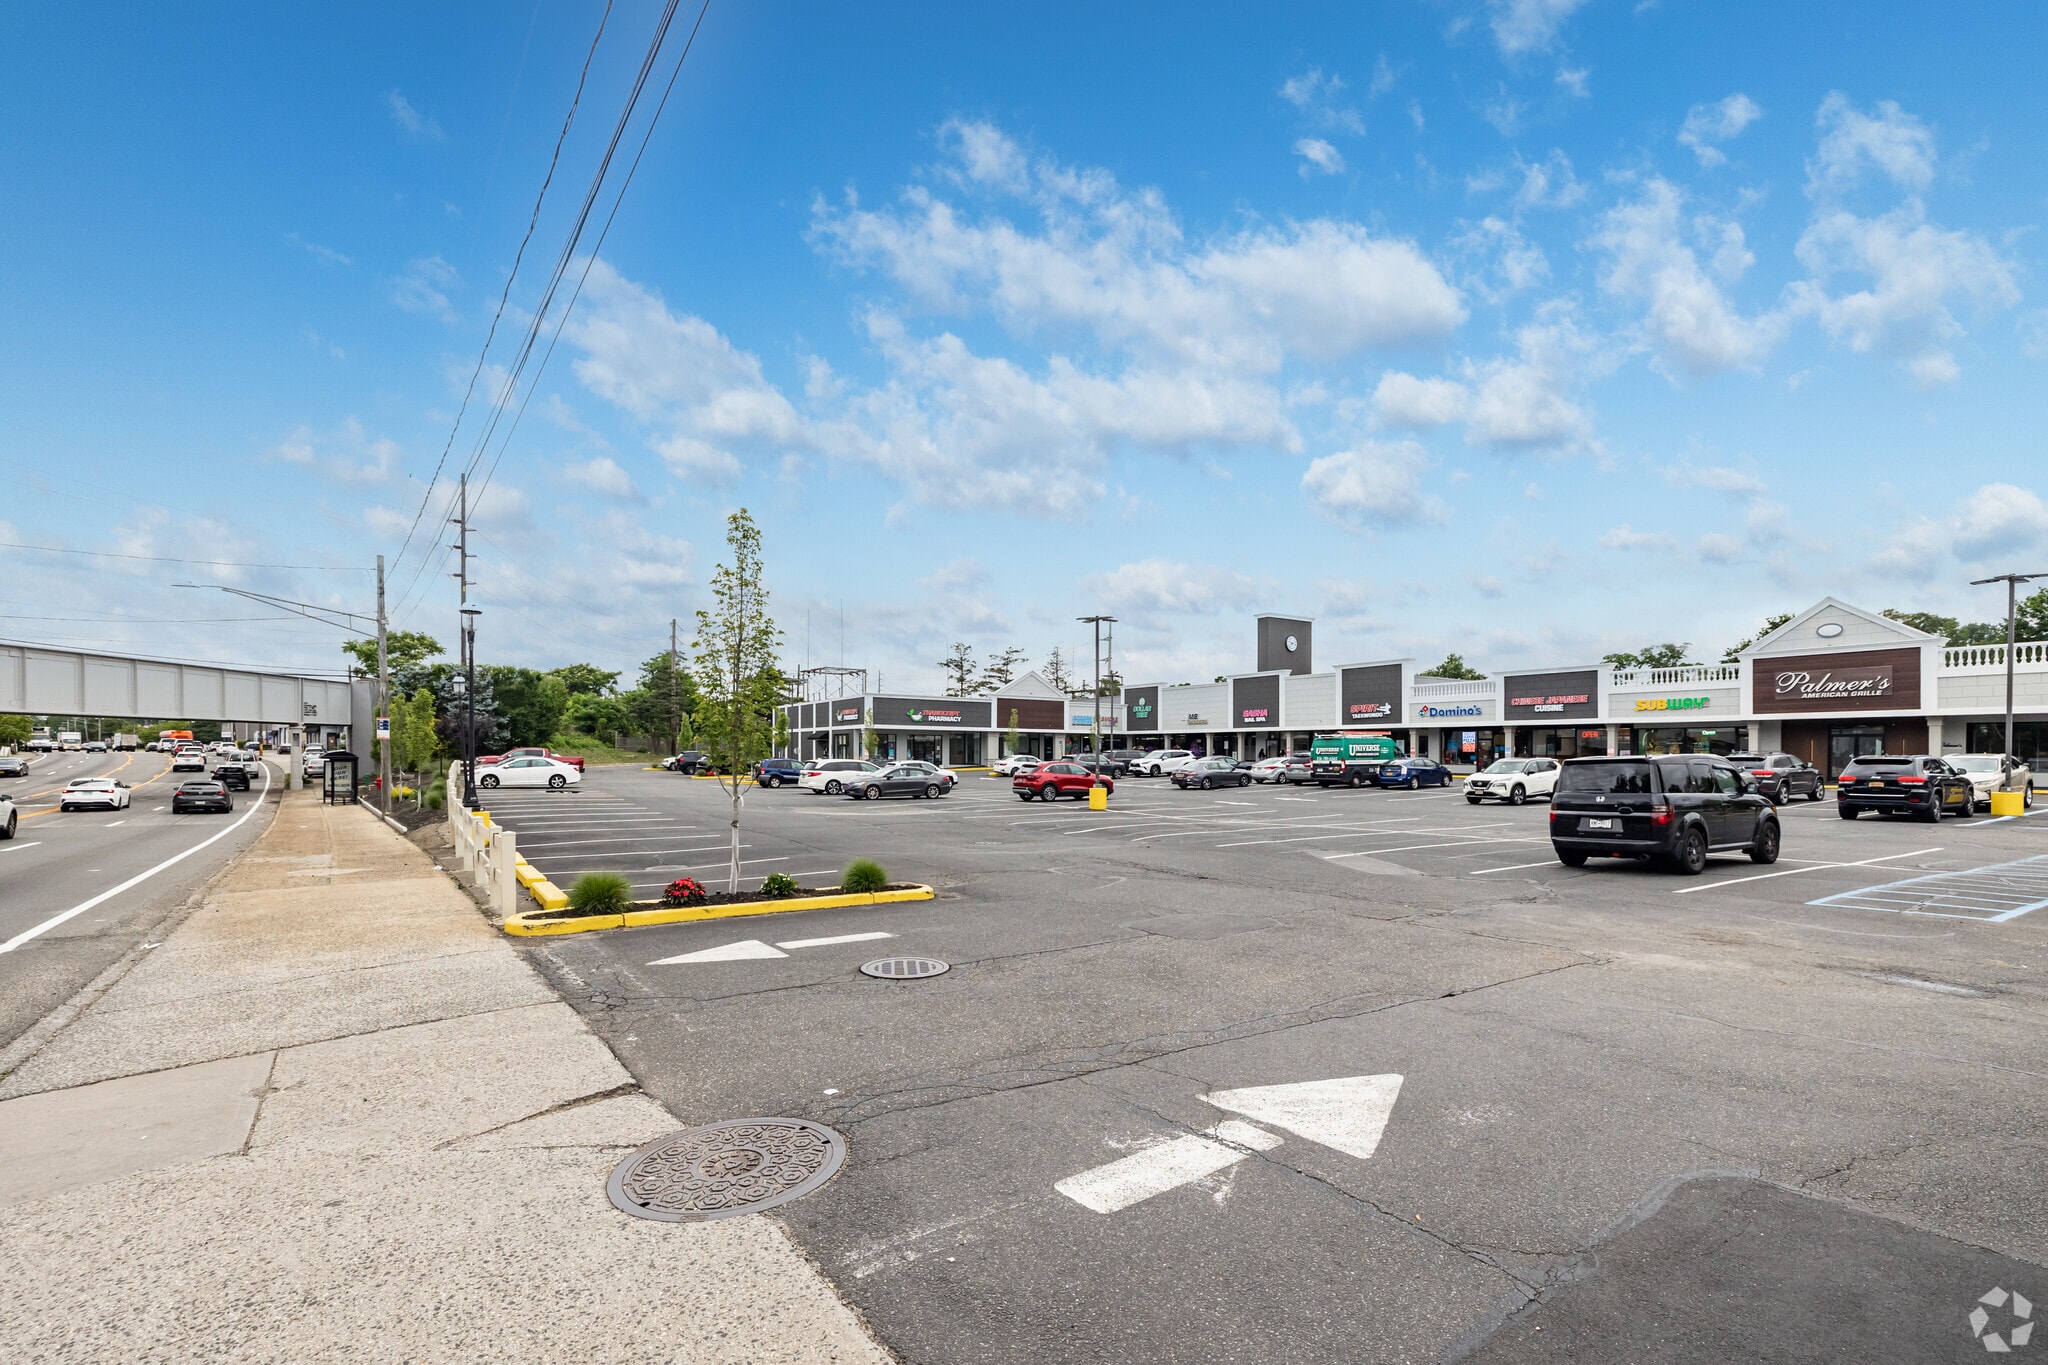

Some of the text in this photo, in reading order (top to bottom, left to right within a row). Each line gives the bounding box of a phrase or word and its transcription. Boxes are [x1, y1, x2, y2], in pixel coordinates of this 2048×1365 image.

[1775, 671, 1891, 694] Palmer's
[1801, 689, 1883, 699] AMERICAN GRILLE
[1511, 695, 1589, 706] CHINESE JAPANESE
[1634, 696, 1710, 712] SUBWAY
[1350, 703, 1379, 713] SPIRIT
[1429, 705, 1483, 717] Domino's
[1535, 704, 1564, 712] CUISINE
[1349, 744, 1381, 757] UNIVERSE
